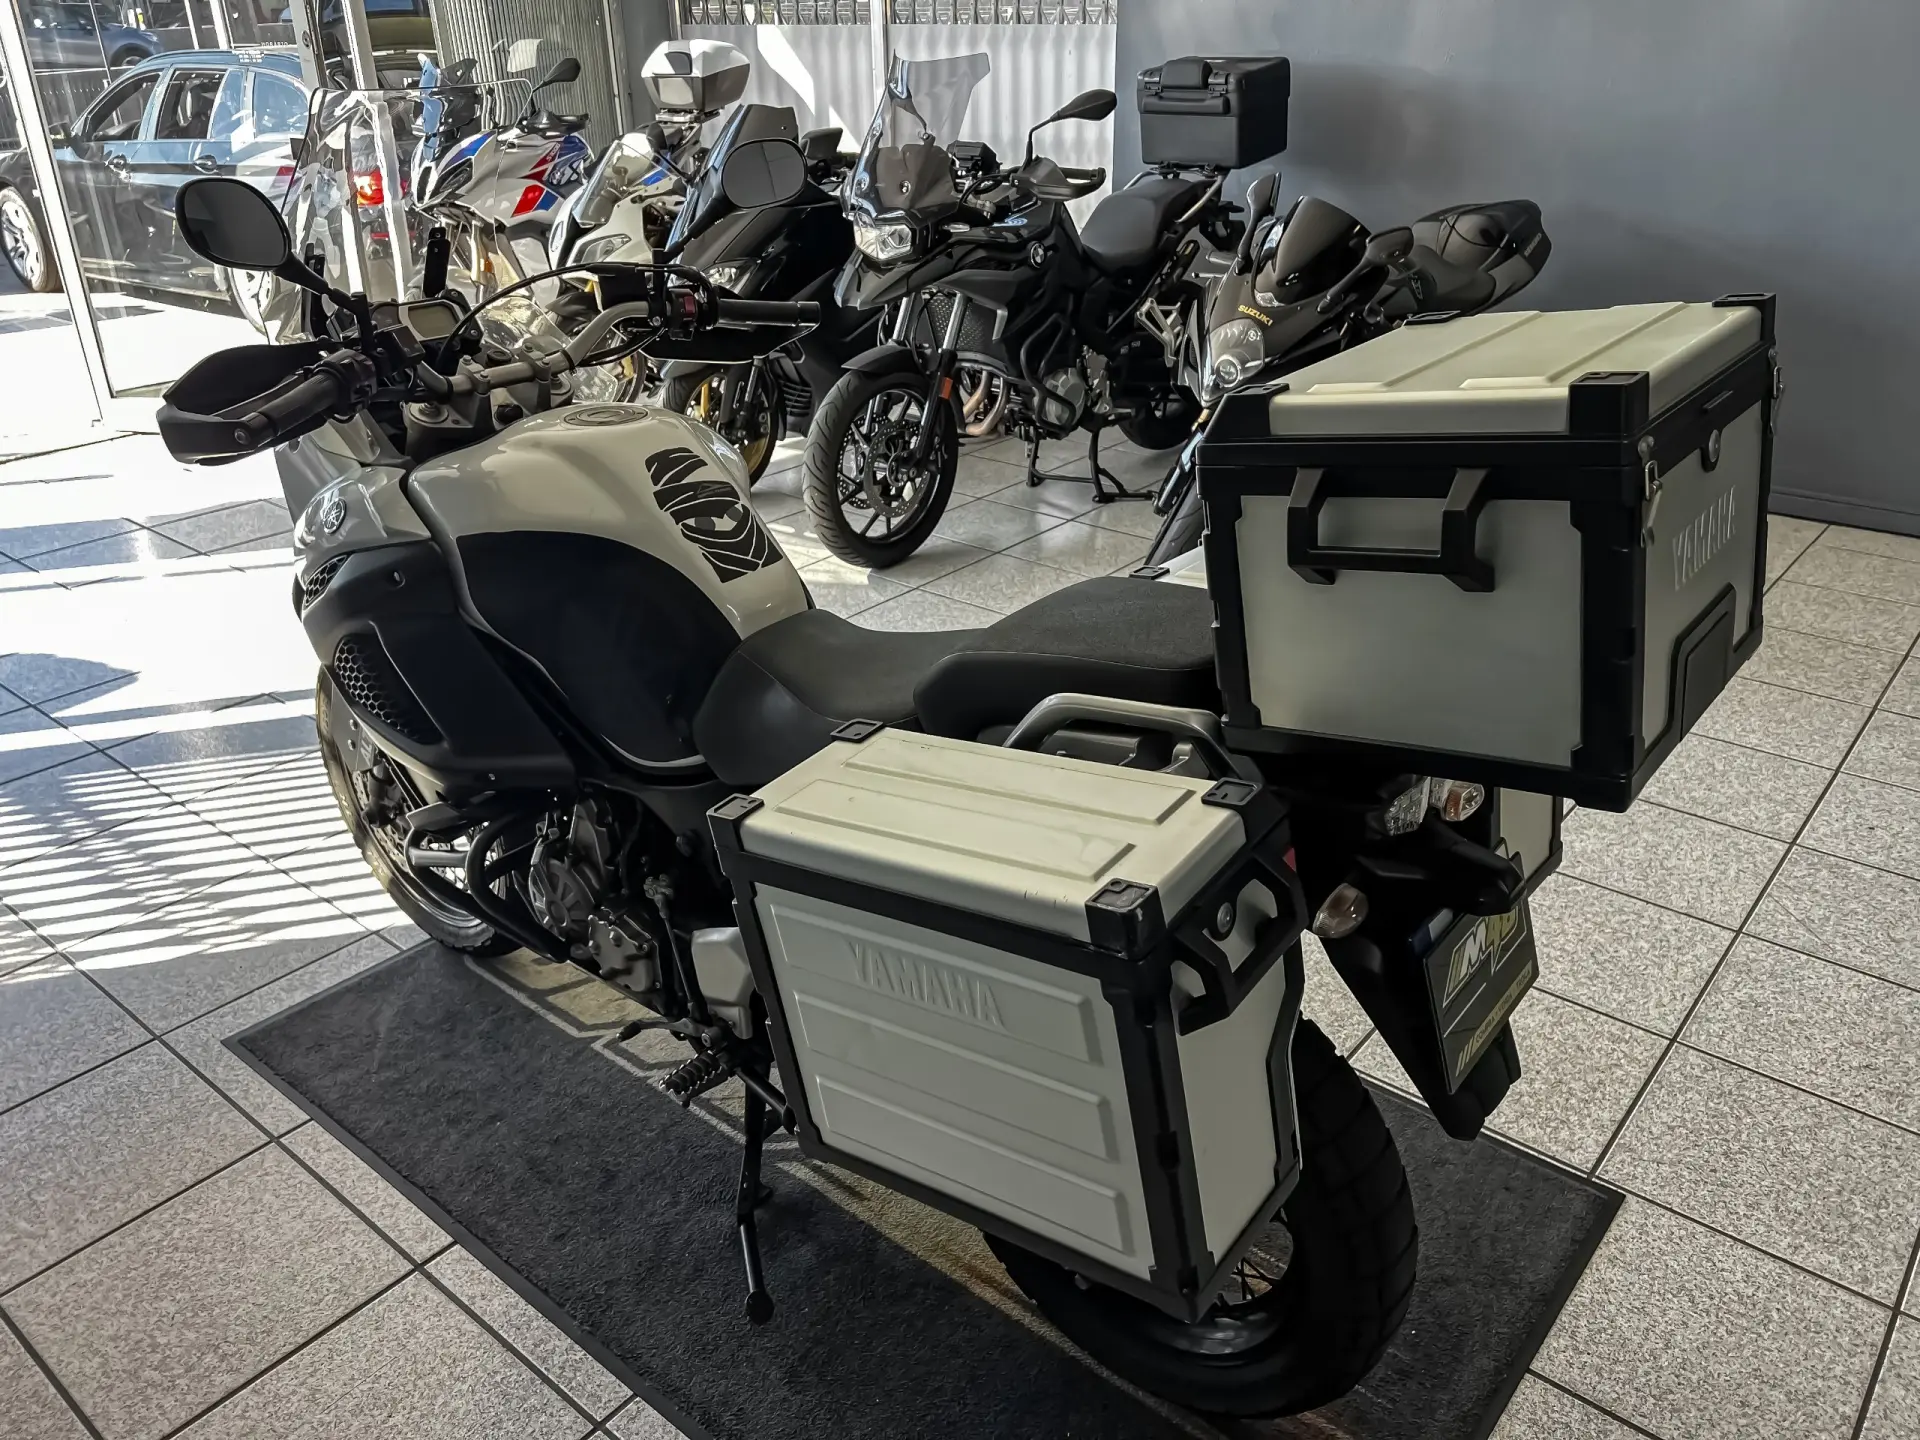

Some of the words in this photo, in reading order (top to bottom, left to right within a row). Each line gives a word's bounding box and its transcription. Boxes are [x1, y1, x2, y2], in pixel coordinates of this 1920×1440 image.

[1238, 304, 1273, 327] SUZUKI
[1672, 485, 1736, 591] YAMAHA
[844, 937, 1008, 1030] YAMAHA
